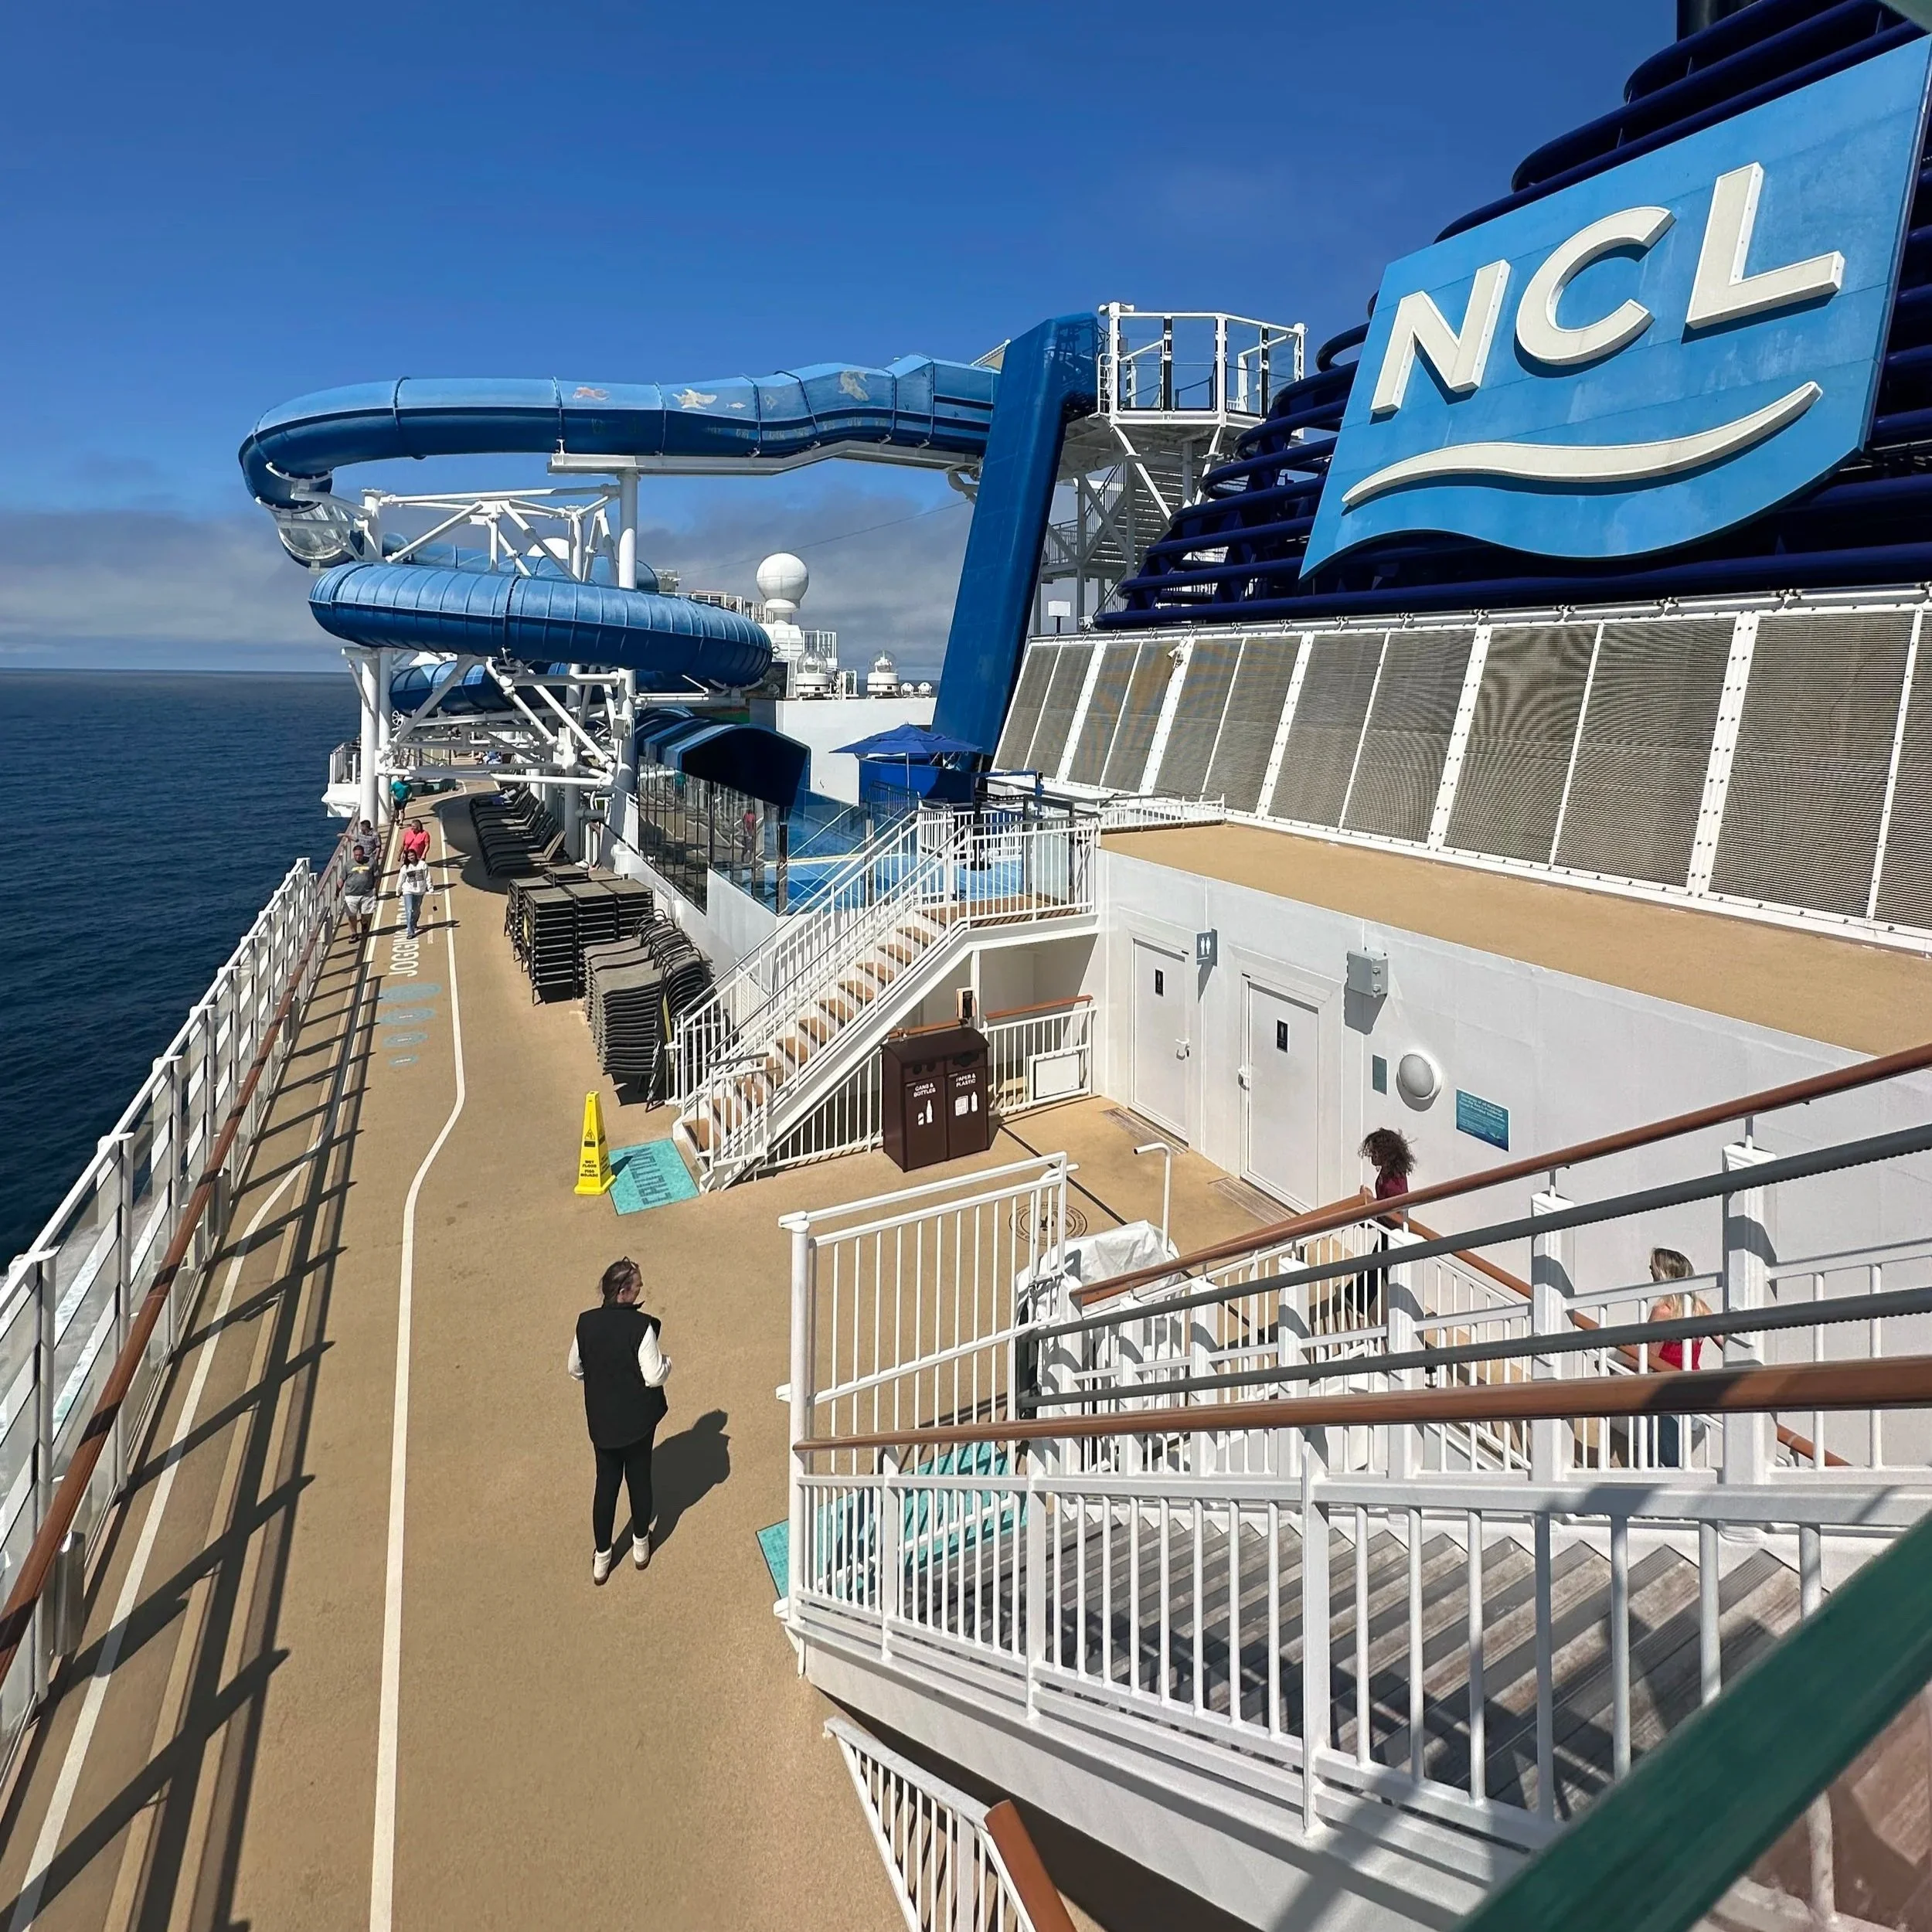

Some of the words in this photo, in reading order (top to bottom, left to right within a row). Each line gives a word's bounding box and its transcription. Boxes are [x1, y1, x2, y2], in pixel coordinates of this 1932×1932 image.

[1370, 162, 1845, 414] NCL
[956, 1079, 976, 1087] PLASTIC
[913, 1087, 936, 1097] BOTTLES
